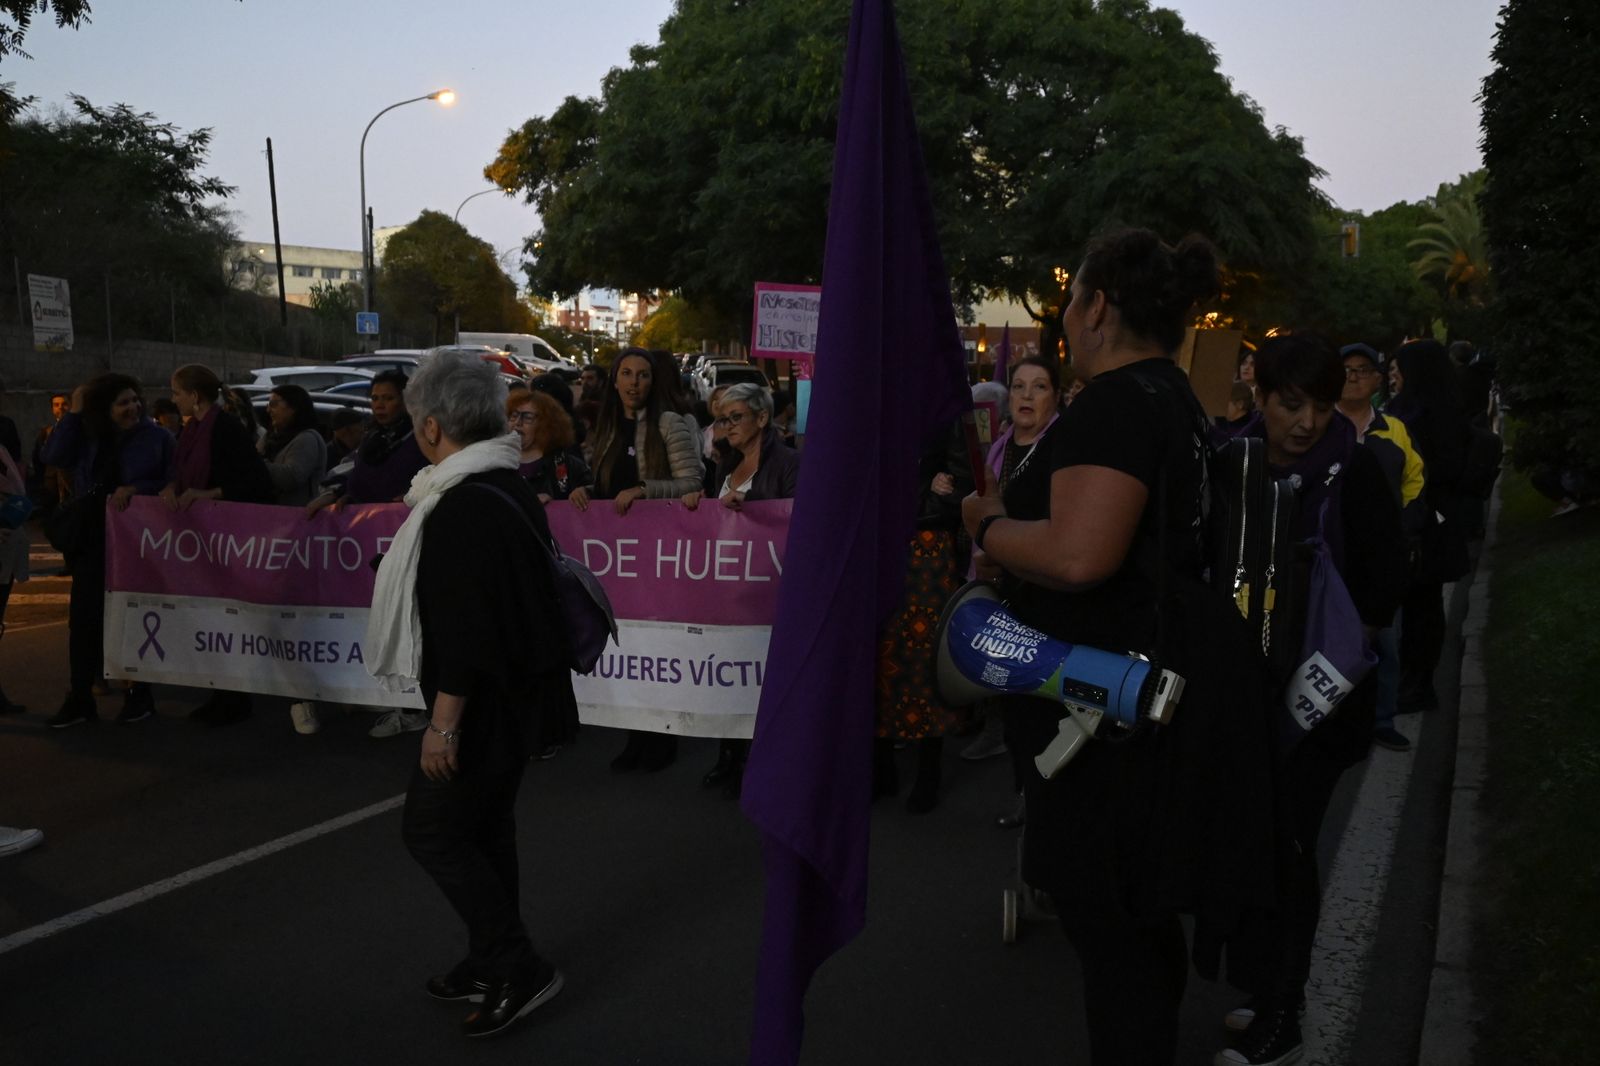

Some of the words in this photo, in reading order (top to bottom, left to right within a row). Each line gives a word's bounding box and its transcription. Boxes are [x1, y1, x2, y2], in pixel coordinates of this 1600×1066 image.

[140, 528, 362, 571] MOVIMIENTO
[583, 538, 639, 577] DE
[195, 631, 233, 654] SIN
[242, 635, 340, 664] HOMBRES
[971, 633, 1037, 663] UNIDAS
[991, 628, 1040, 647] PARAMOS
